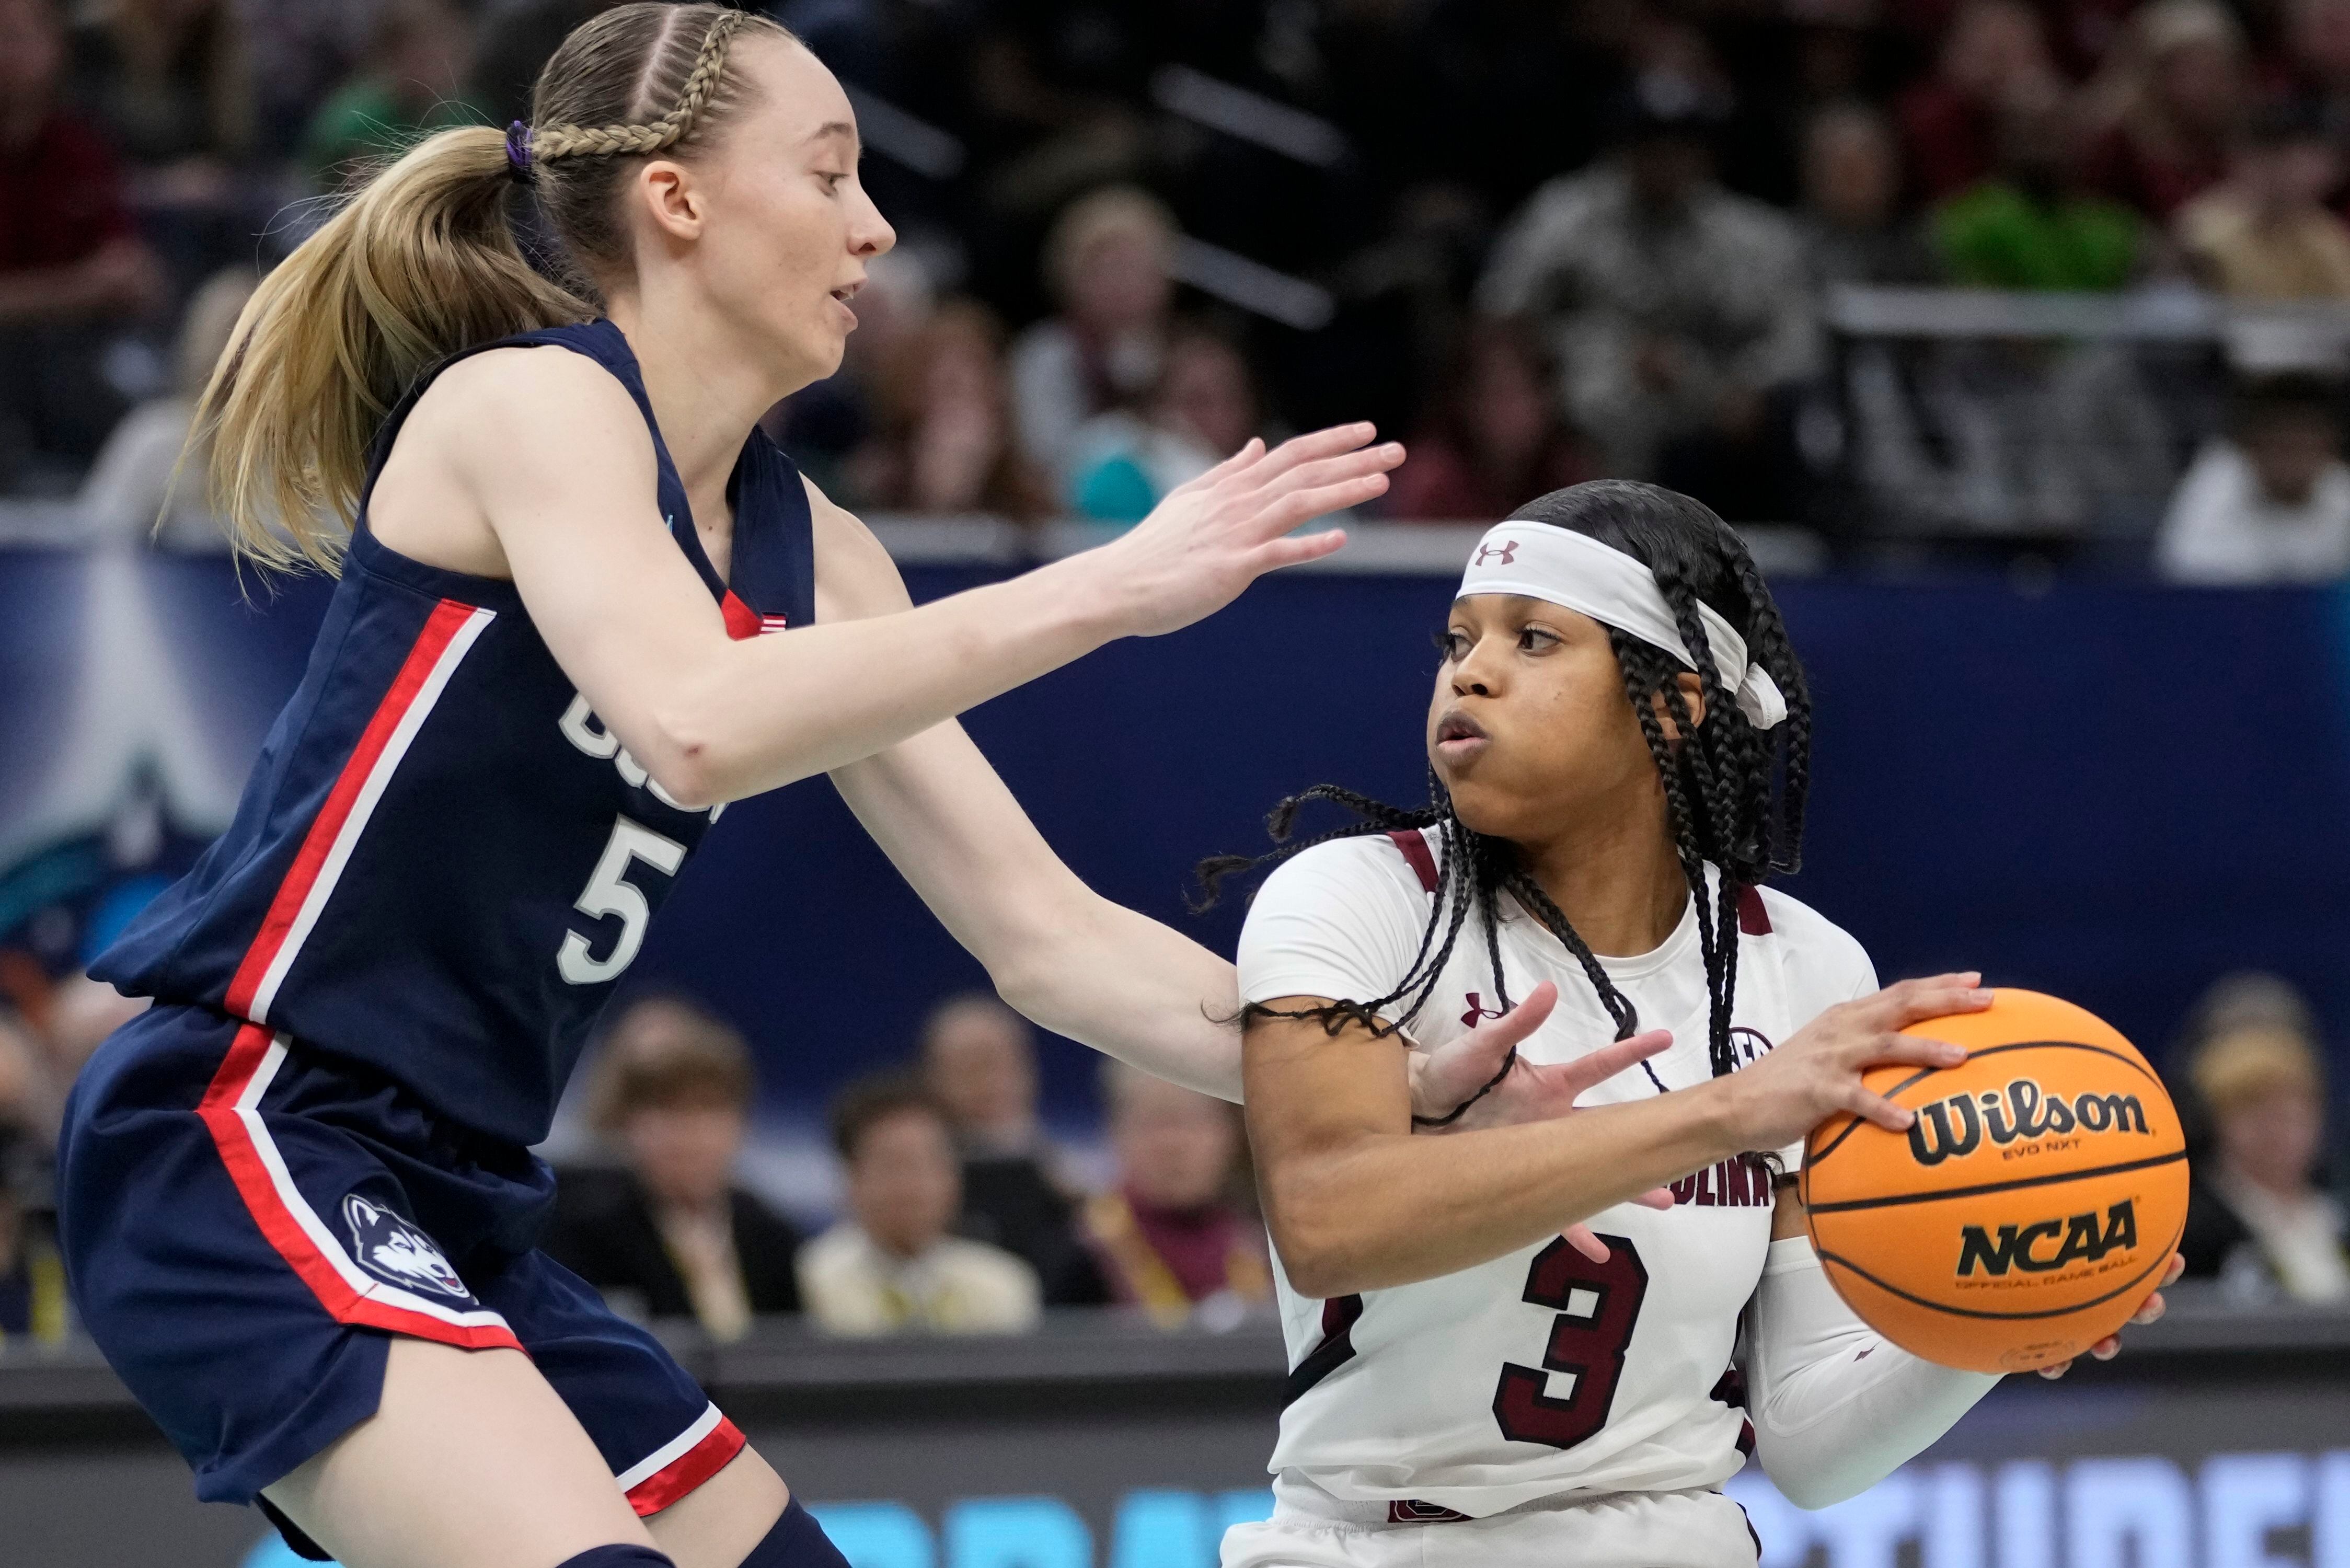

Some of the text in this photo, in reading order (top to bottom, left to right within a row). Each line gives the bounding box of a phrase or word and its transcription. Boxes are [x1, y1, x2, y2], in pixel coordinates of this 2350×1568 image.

[557, 812, 688, 985] 5
[1906, 1077, 2150, 1167] Wilson
[2002, 1138, 2080, 1161] EVO NXT
[1955, 1198, 2138, 1277] NCAA
[1492, 1232, 1649, 1450] 3
